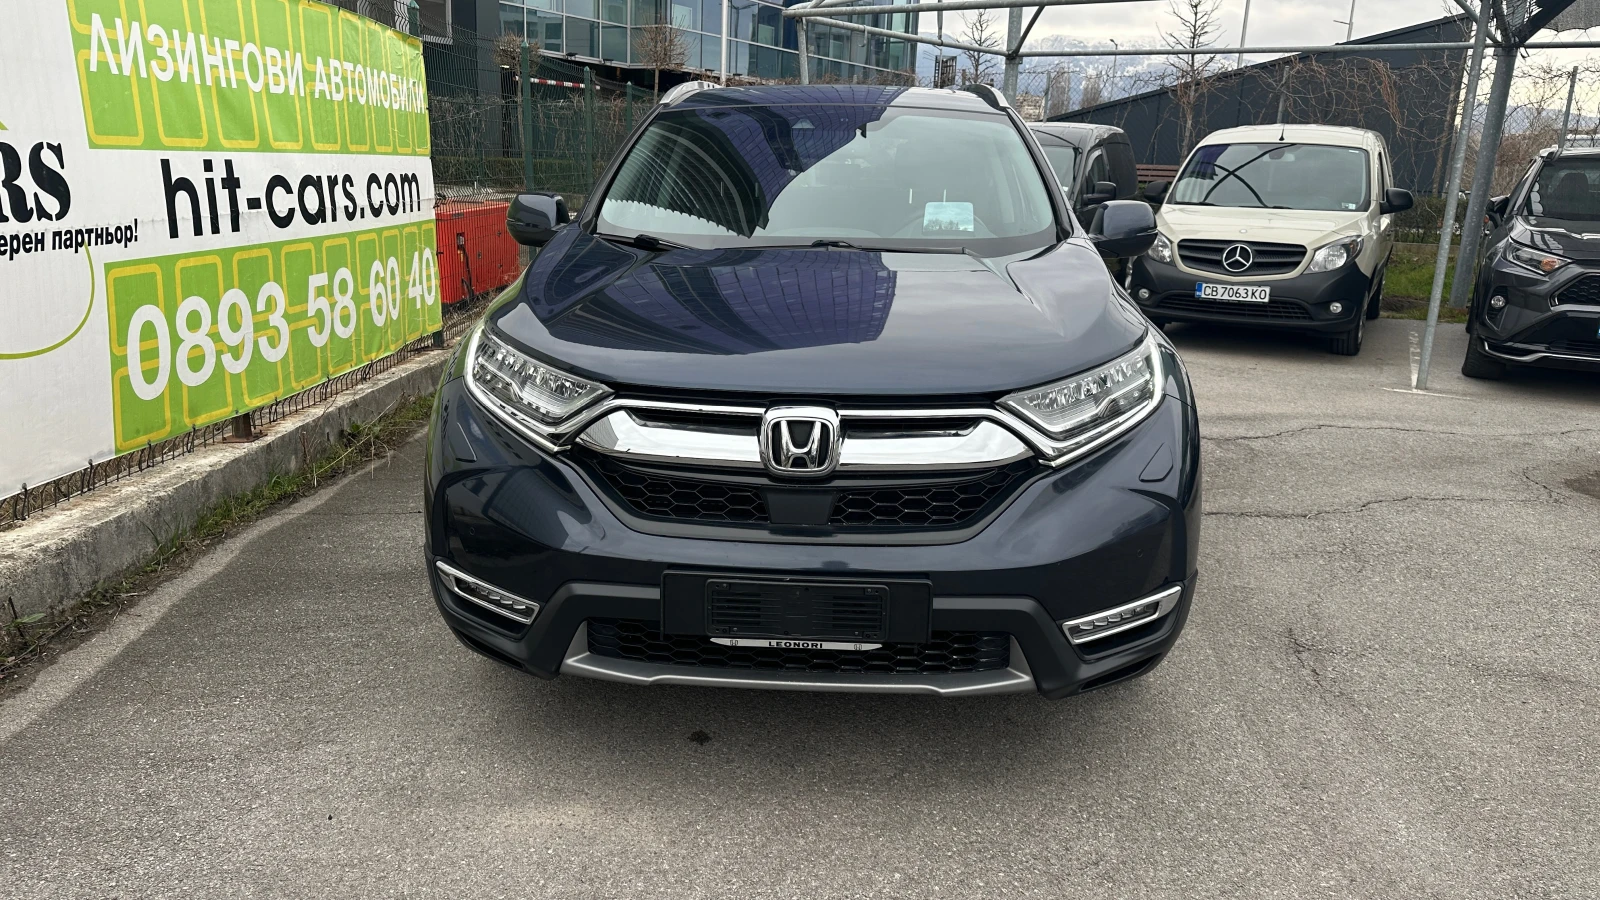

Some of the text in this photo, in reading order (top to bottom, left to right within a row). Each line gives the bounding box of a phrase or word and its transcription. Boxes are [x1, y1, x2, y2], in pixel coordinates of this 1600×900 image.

[89, 13, 425, 114] ЛИЗИНГОВИ АВТОМОБИЛИ
[160, 158, 421, 239] hit-cars.com
[52, 218, 138, 253] партньор!
[1203, 285, 1219, 297] CB
[1220, 286, 1249, 299] 7063
[127, 247, 436, 400] 0893 58 60 40
[768, 640, 823, 649] LEONORI
